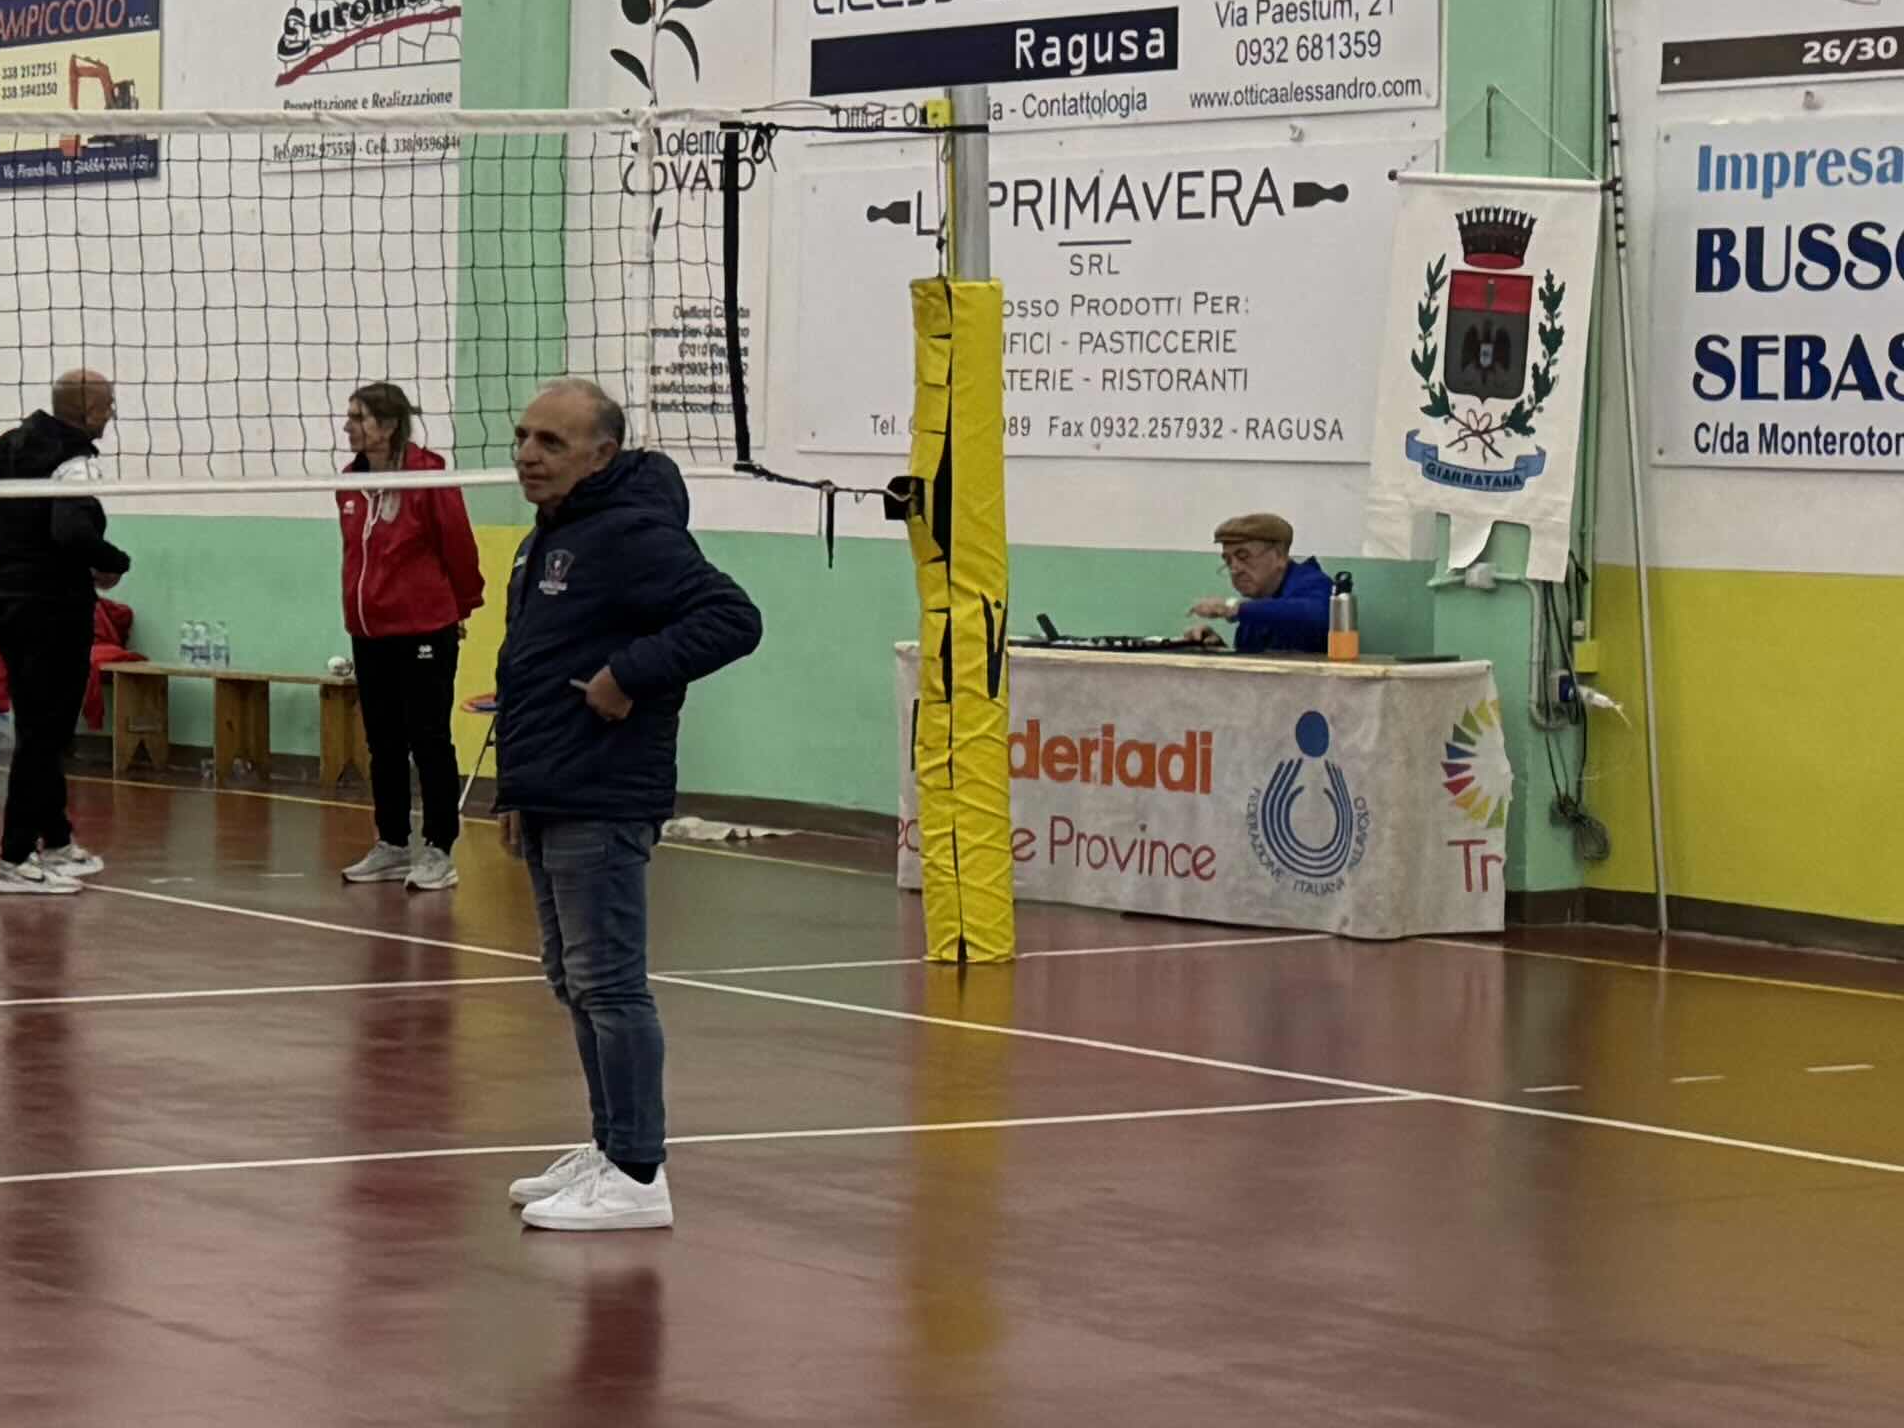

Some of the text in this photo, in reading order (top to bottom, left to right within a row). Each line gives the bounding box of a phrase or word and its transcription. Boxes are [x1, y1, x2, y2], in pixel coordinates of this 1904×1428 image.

[1215, 0, 1248, 29] Via
[1015, 27, 1166, 75] Ragusa
[1236, 29, 1382, 67] 0932 681359
[1802, 36, 1898, 65] 26/30
[371, 88, 453, 108] Realizzazione
[1022, 87, 1148, 119] Contattologia
[1189, 76, 1423, 110] www.otticaalessandro.com
[1698, 145, 1904, 200] Impresa
[1068, 253, 1121, 277] SRL
[1696, 222, 1904, 293] BUSS
[1002, 331, 1052, 355] IFICI
[1079, 329, 1238, 354] PASTICCERIE
[1101, 368, 1249, 392] RISTORANTI
[870, 414, 902, 437] Tel.
[1048, 415, 1084, 438] Fax
[1090, 416, 1224, 440] 0932.257932
[1245, 417, 1344, 442] RAGUSA
[1695, 423, 1749, 454] C/da
[1425, 463, 1523, 488] GIARRATANA
[1008, 719, 1213, 795] deriadi
[1049, 815, 1217, 882] Province
